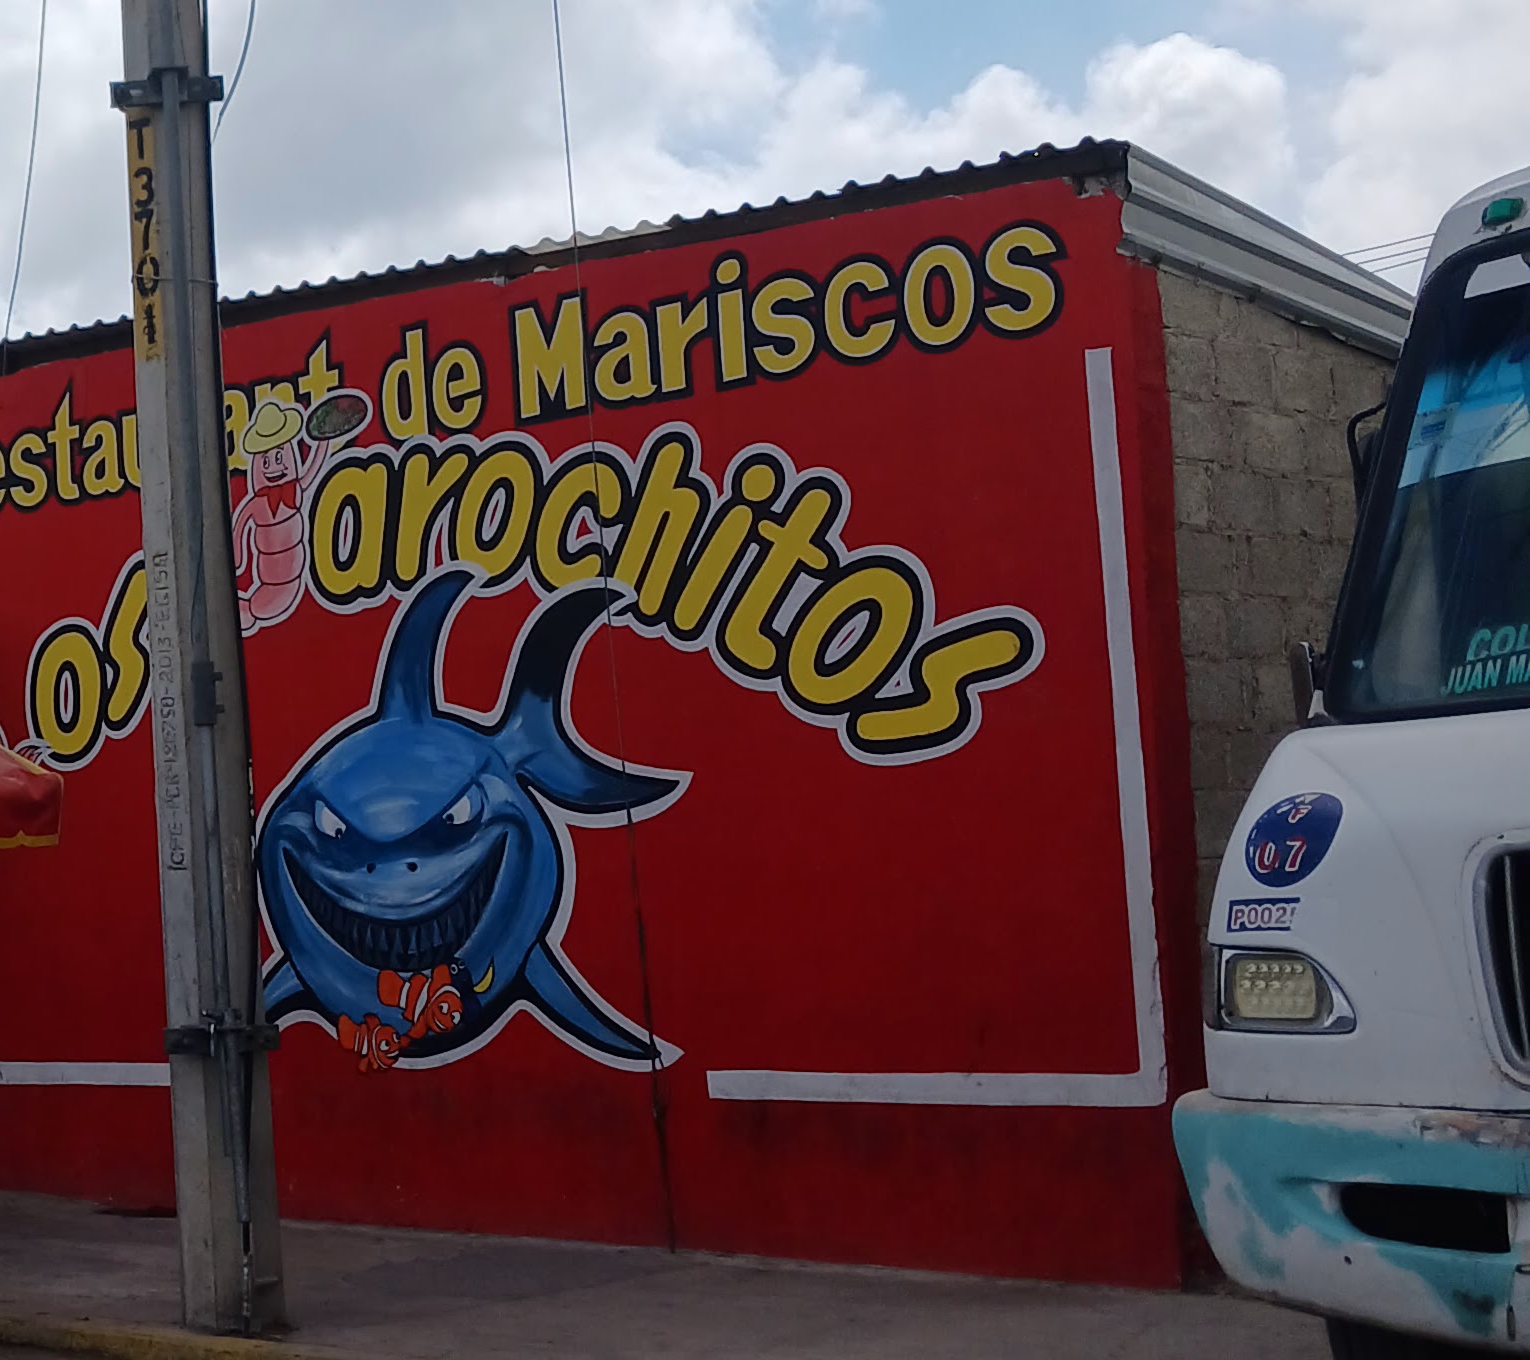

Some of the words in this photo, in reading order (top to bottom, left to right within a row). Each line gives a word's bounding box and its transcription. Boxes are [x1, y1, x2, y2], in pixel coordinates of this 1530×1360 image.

[380, 324, 483, 441] de
[512, 223, 1062, 421] Mariscos
[1441, 659, 1501, 696] JUAN
[1255, 836, 1307, 873] 07
